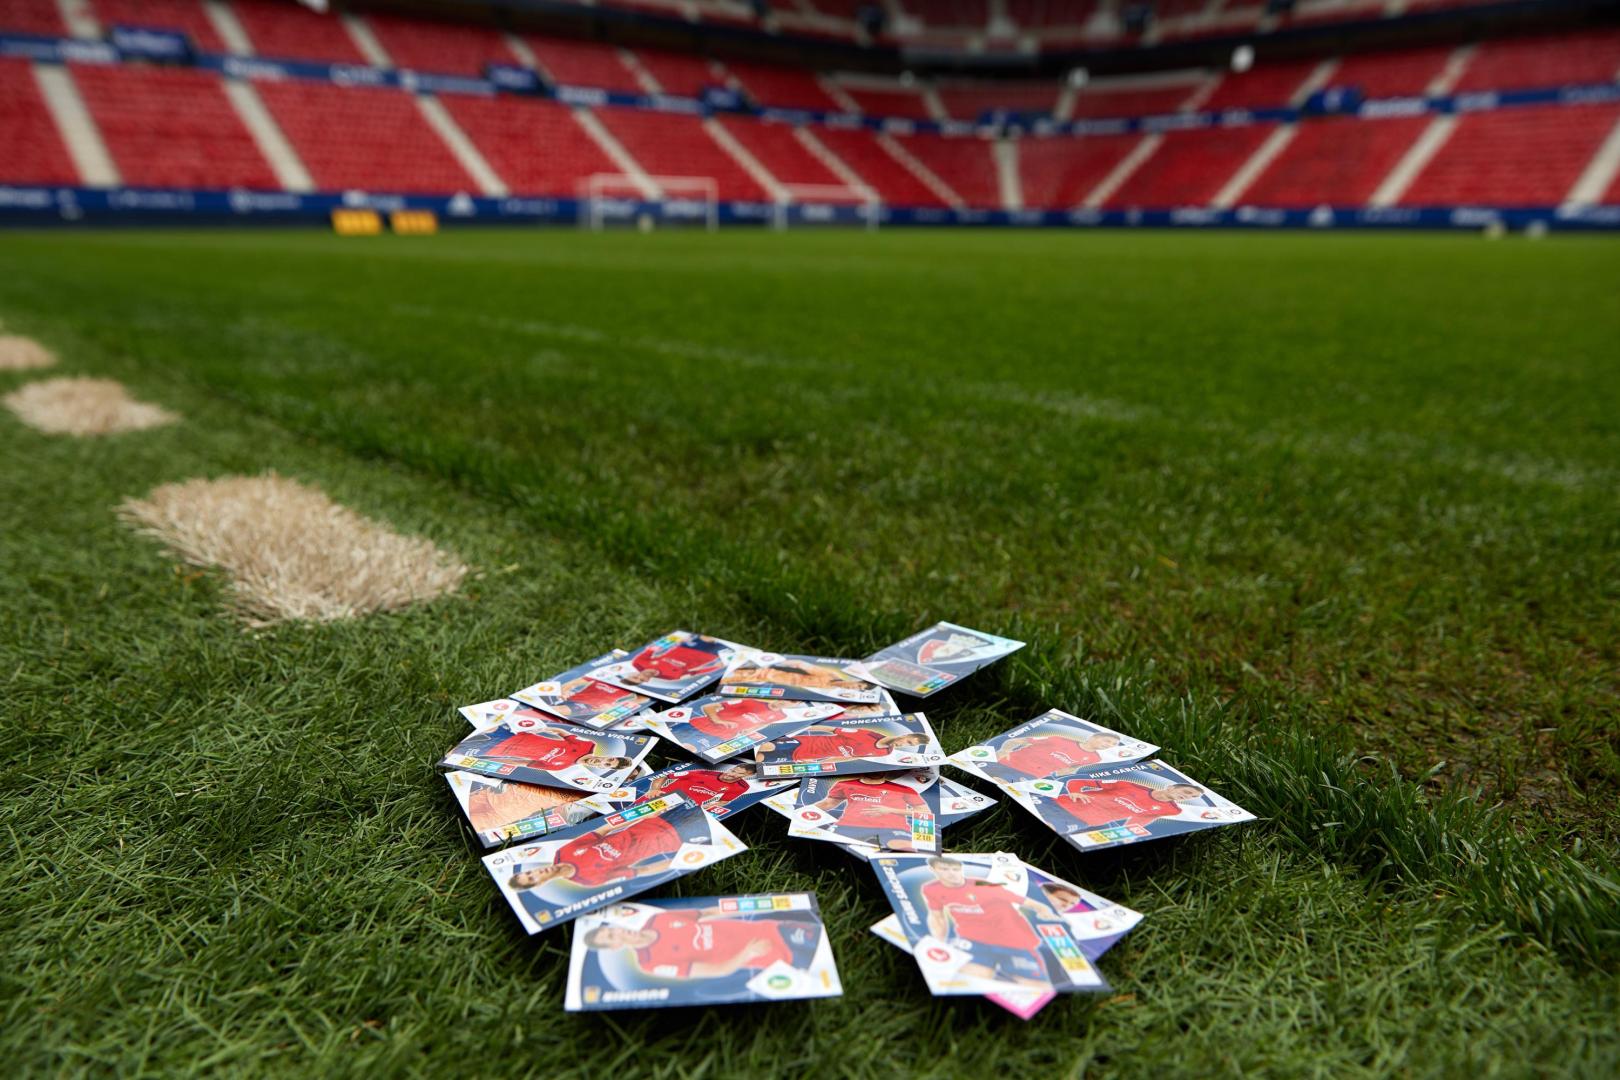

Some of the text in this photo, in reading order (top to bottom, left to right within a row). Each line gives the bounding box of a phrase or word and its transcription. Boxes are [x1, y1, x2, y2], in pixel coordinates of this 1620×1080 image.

[841, 716, 902, 725] MONCAYOLA
[569, 727, 635, 742] NACHO VIDAL
[1089, 764, 1149, 779] KIKE GARCÍA
[554, 886, 623, 918] BRASANAC
